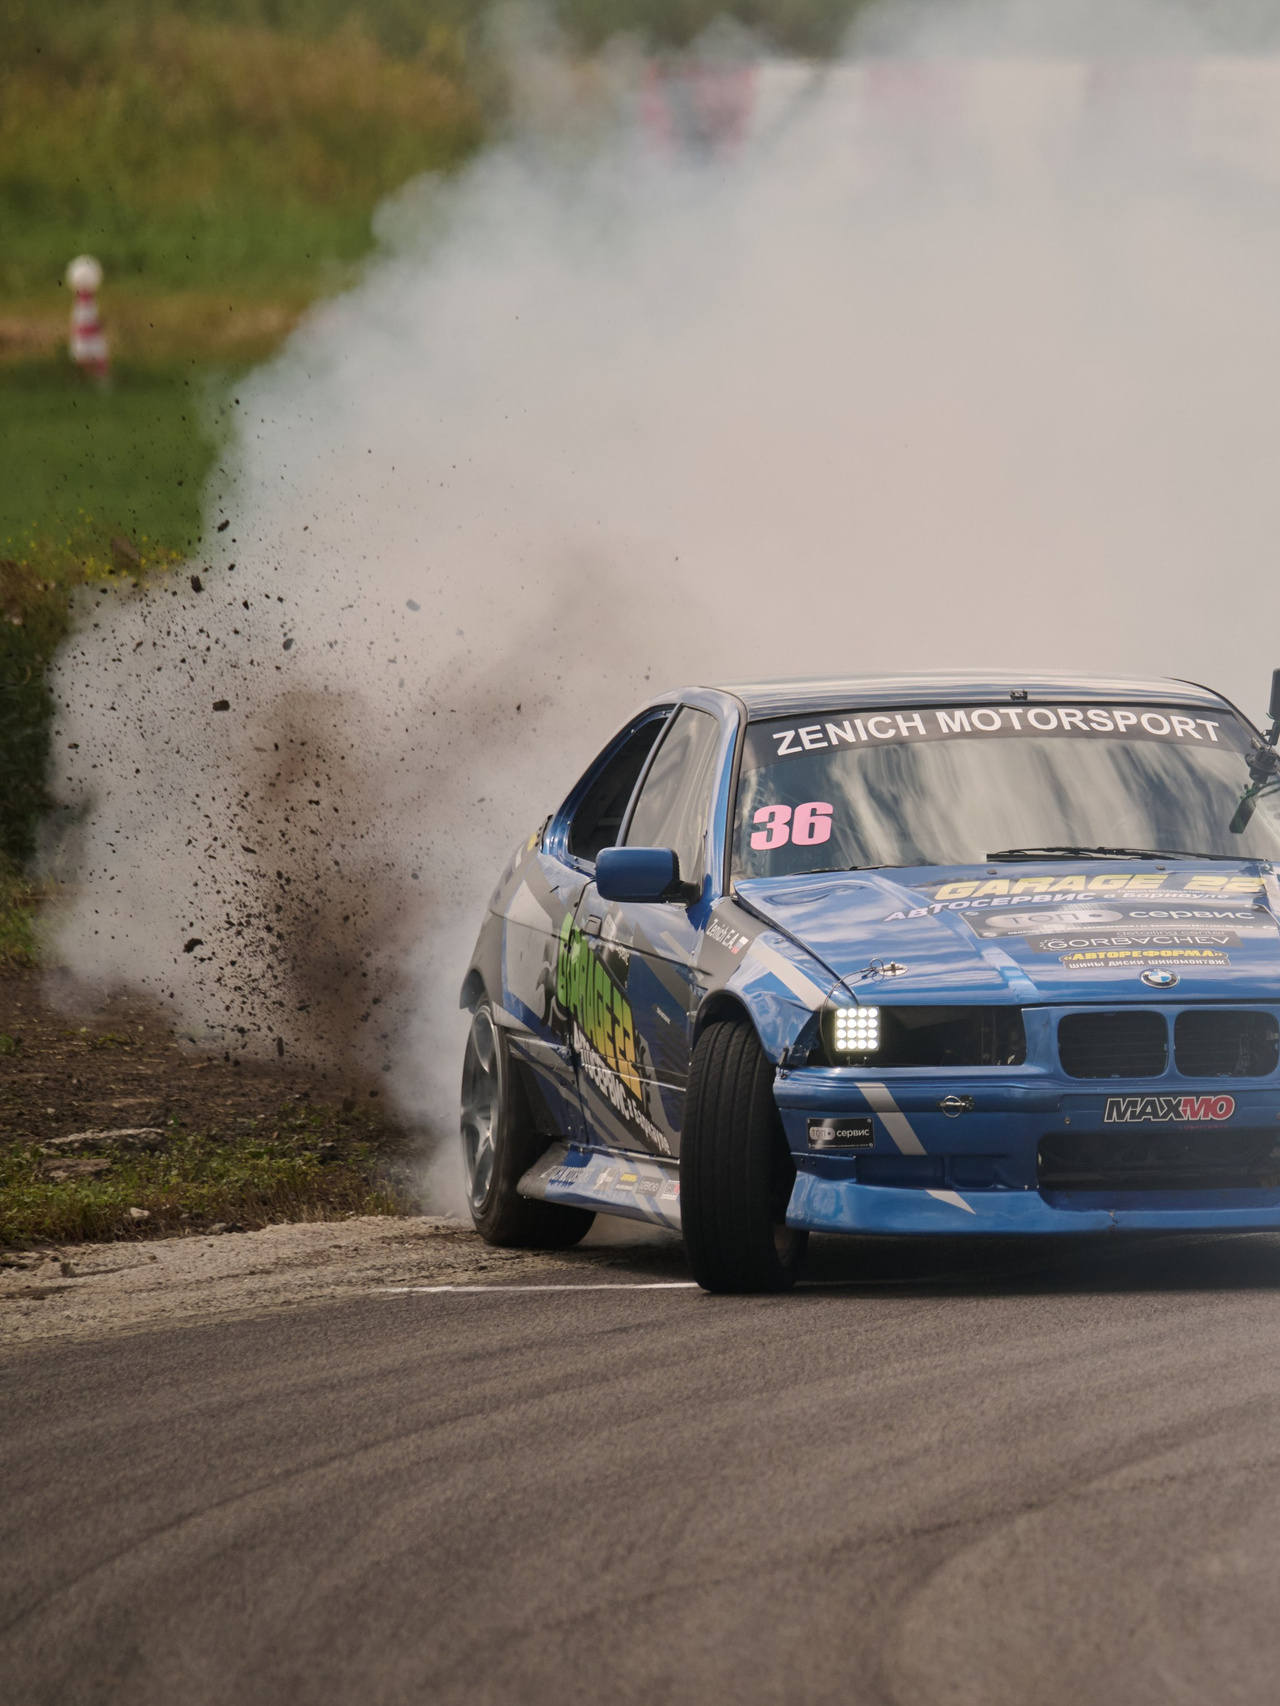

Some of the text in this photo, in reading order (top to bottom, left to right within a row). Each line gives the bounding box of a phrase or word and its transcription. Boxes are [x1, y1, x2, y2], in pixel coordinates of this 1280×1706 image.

[772, 708, 1219, 756] ZENICH MOTORSPORT
[750, 801, 834, 851] 36
[935, 874, 1266, 900] GARAGE 22
[883, 892, 1096, 922] АВТОСЕРВИС
[1122, 891, 1230, 900] Барнауле
[1005, 910, 1256, 924] ТОП сервис
[706, 918, 729, 943] Zenich
[1104, 1095, 1235, 1122] MAXMO
[836, 1128, 870, 1138] сервис
